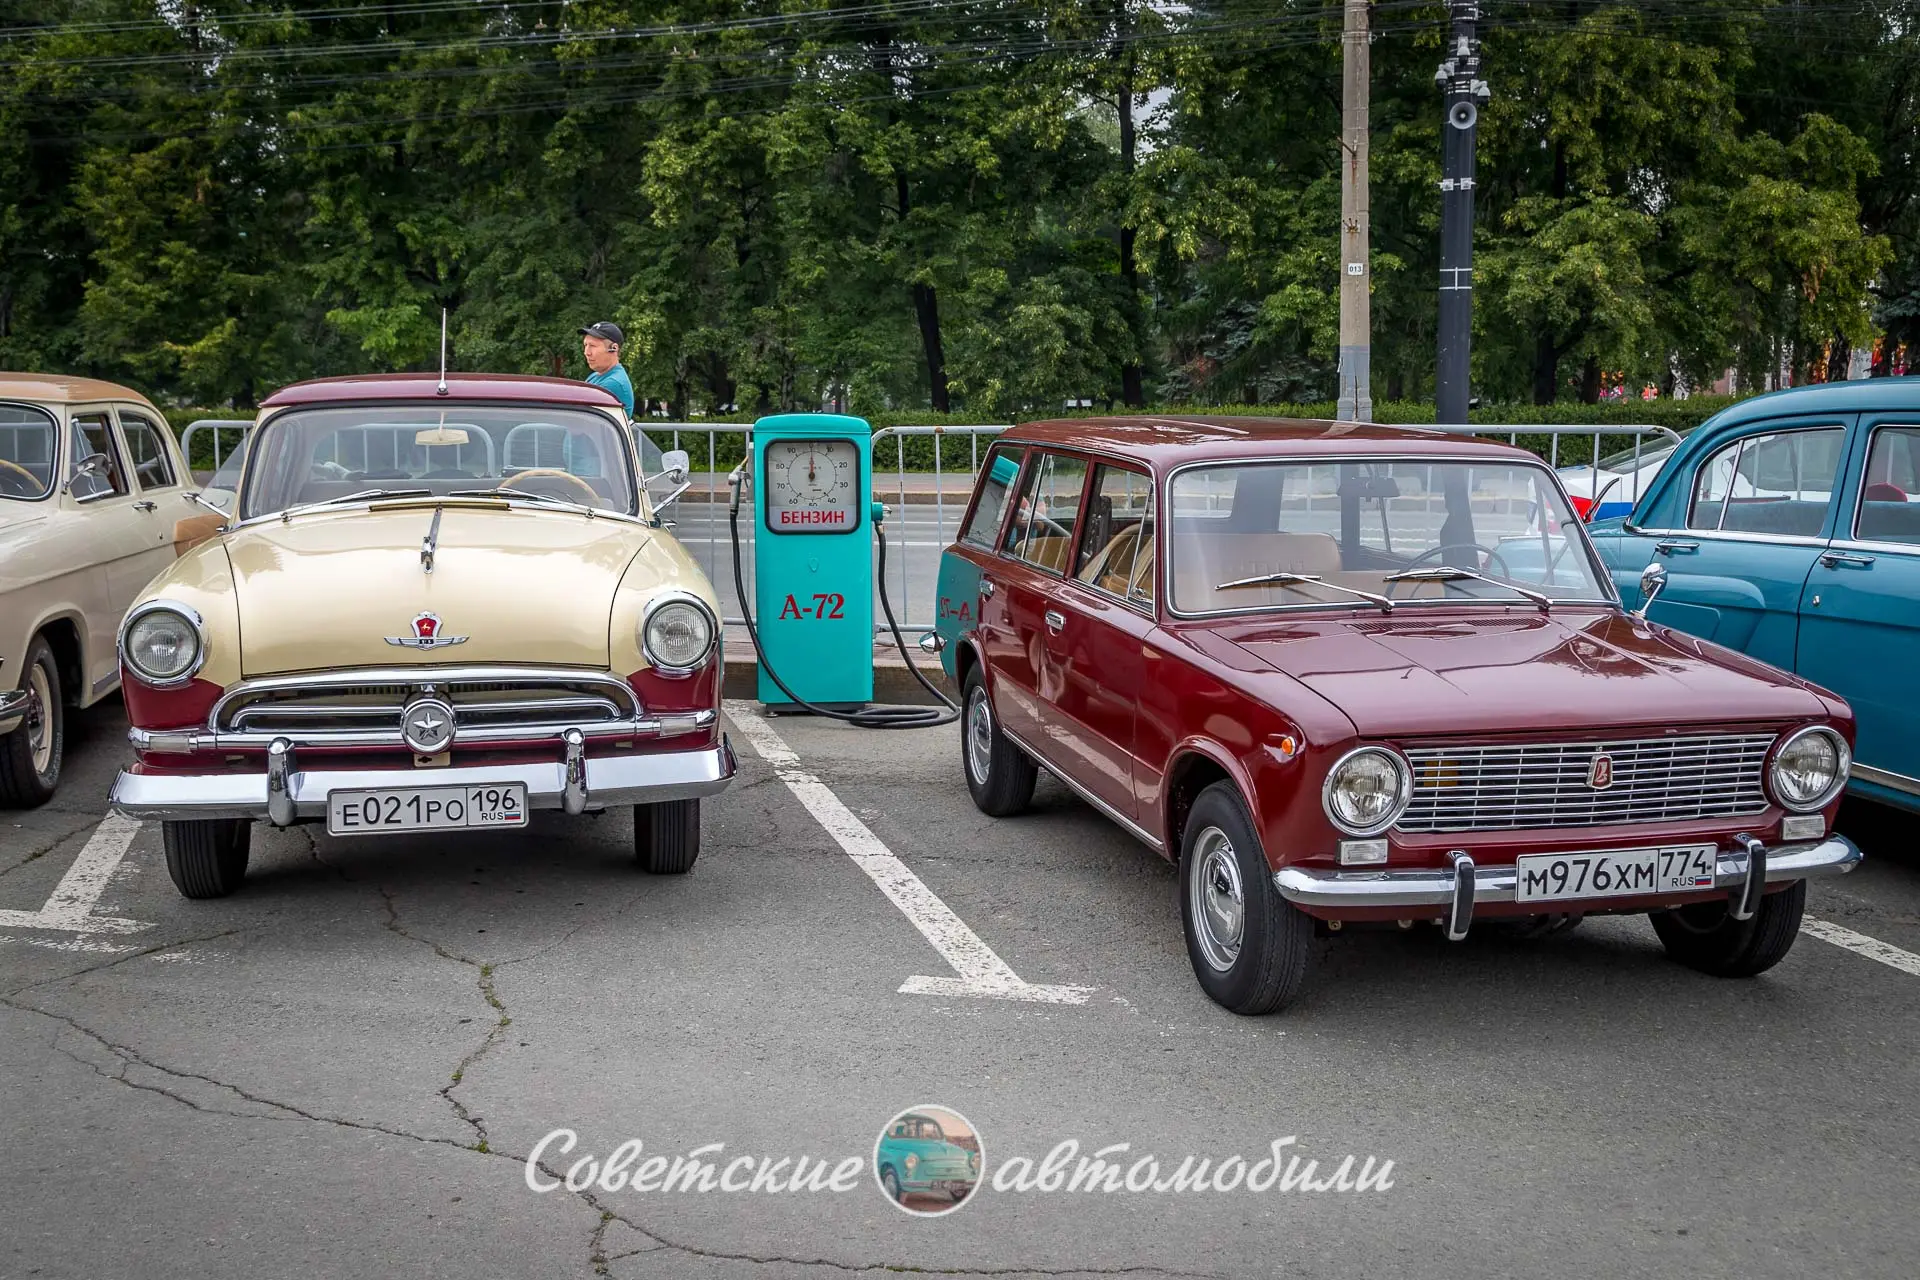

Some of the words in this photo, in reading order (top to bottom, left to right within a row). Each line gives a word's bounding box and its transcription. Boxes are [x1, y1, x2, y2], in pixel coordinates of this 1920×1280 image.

[781, 511, 845, 524] БЕНЗИН
[778, 593, 845, 620] А-72
[343, 794, 464, 826] Е021РО
[471, 789, 516, 811] 196
[481, 812, 504, 821] RUS
[1527, 858, 1655, 895] М976ХМ
[1660, 850, 1706, 877] 774
[1672, 876, 1694, 887] RUS
